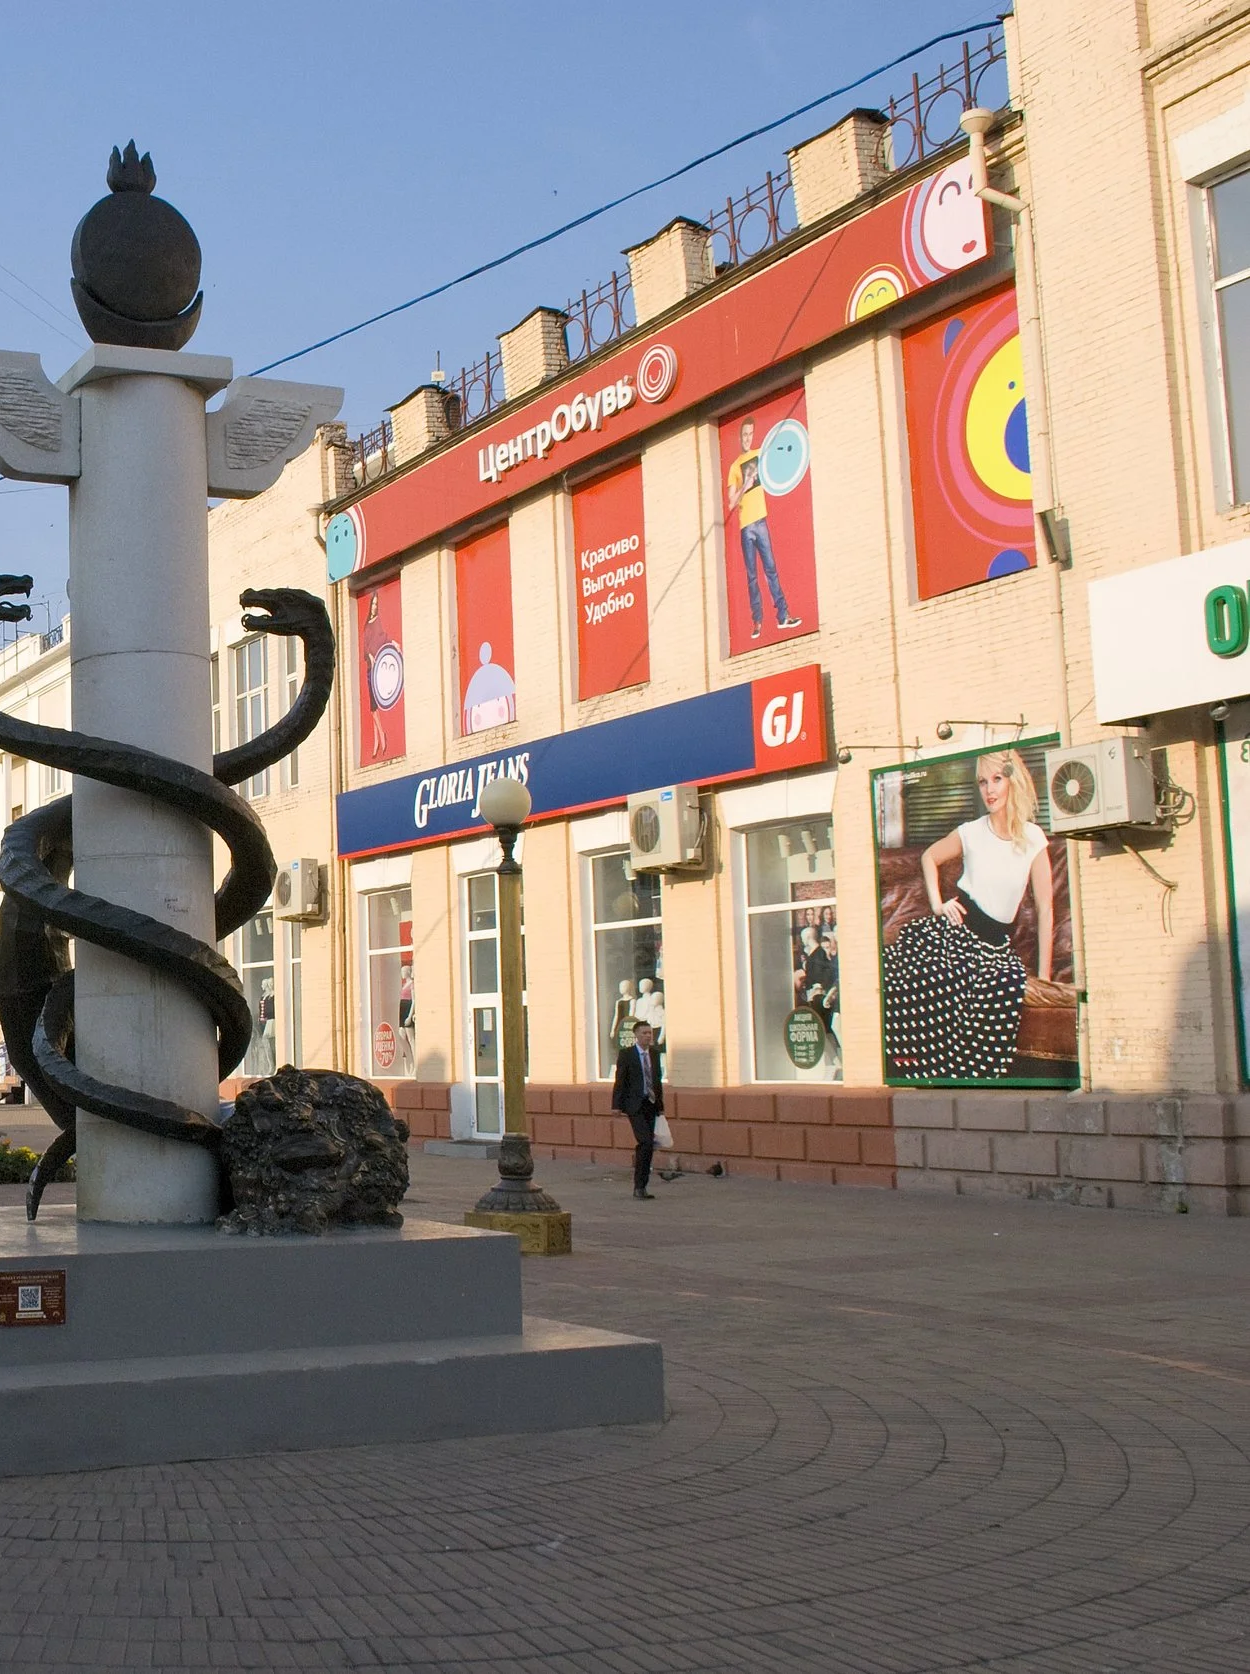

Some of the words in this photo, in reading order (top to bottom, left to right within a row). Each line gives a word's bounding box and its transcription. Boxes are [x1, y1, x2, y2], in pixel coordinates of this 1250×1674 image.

[478, 377, 634, 483] ЦентрОбувь
[581, 535, 639, 573] Красиво
[582, 561, 644, 598] Выгодно
[584, 592, 634, 625] Удобно
[761, 691, 805, 748] GJ
[414, 767, 474, 828] GLORIA
[471, 752, 530, 818] JEANS
[790, 1031, 819, 1042] ФОРМА
